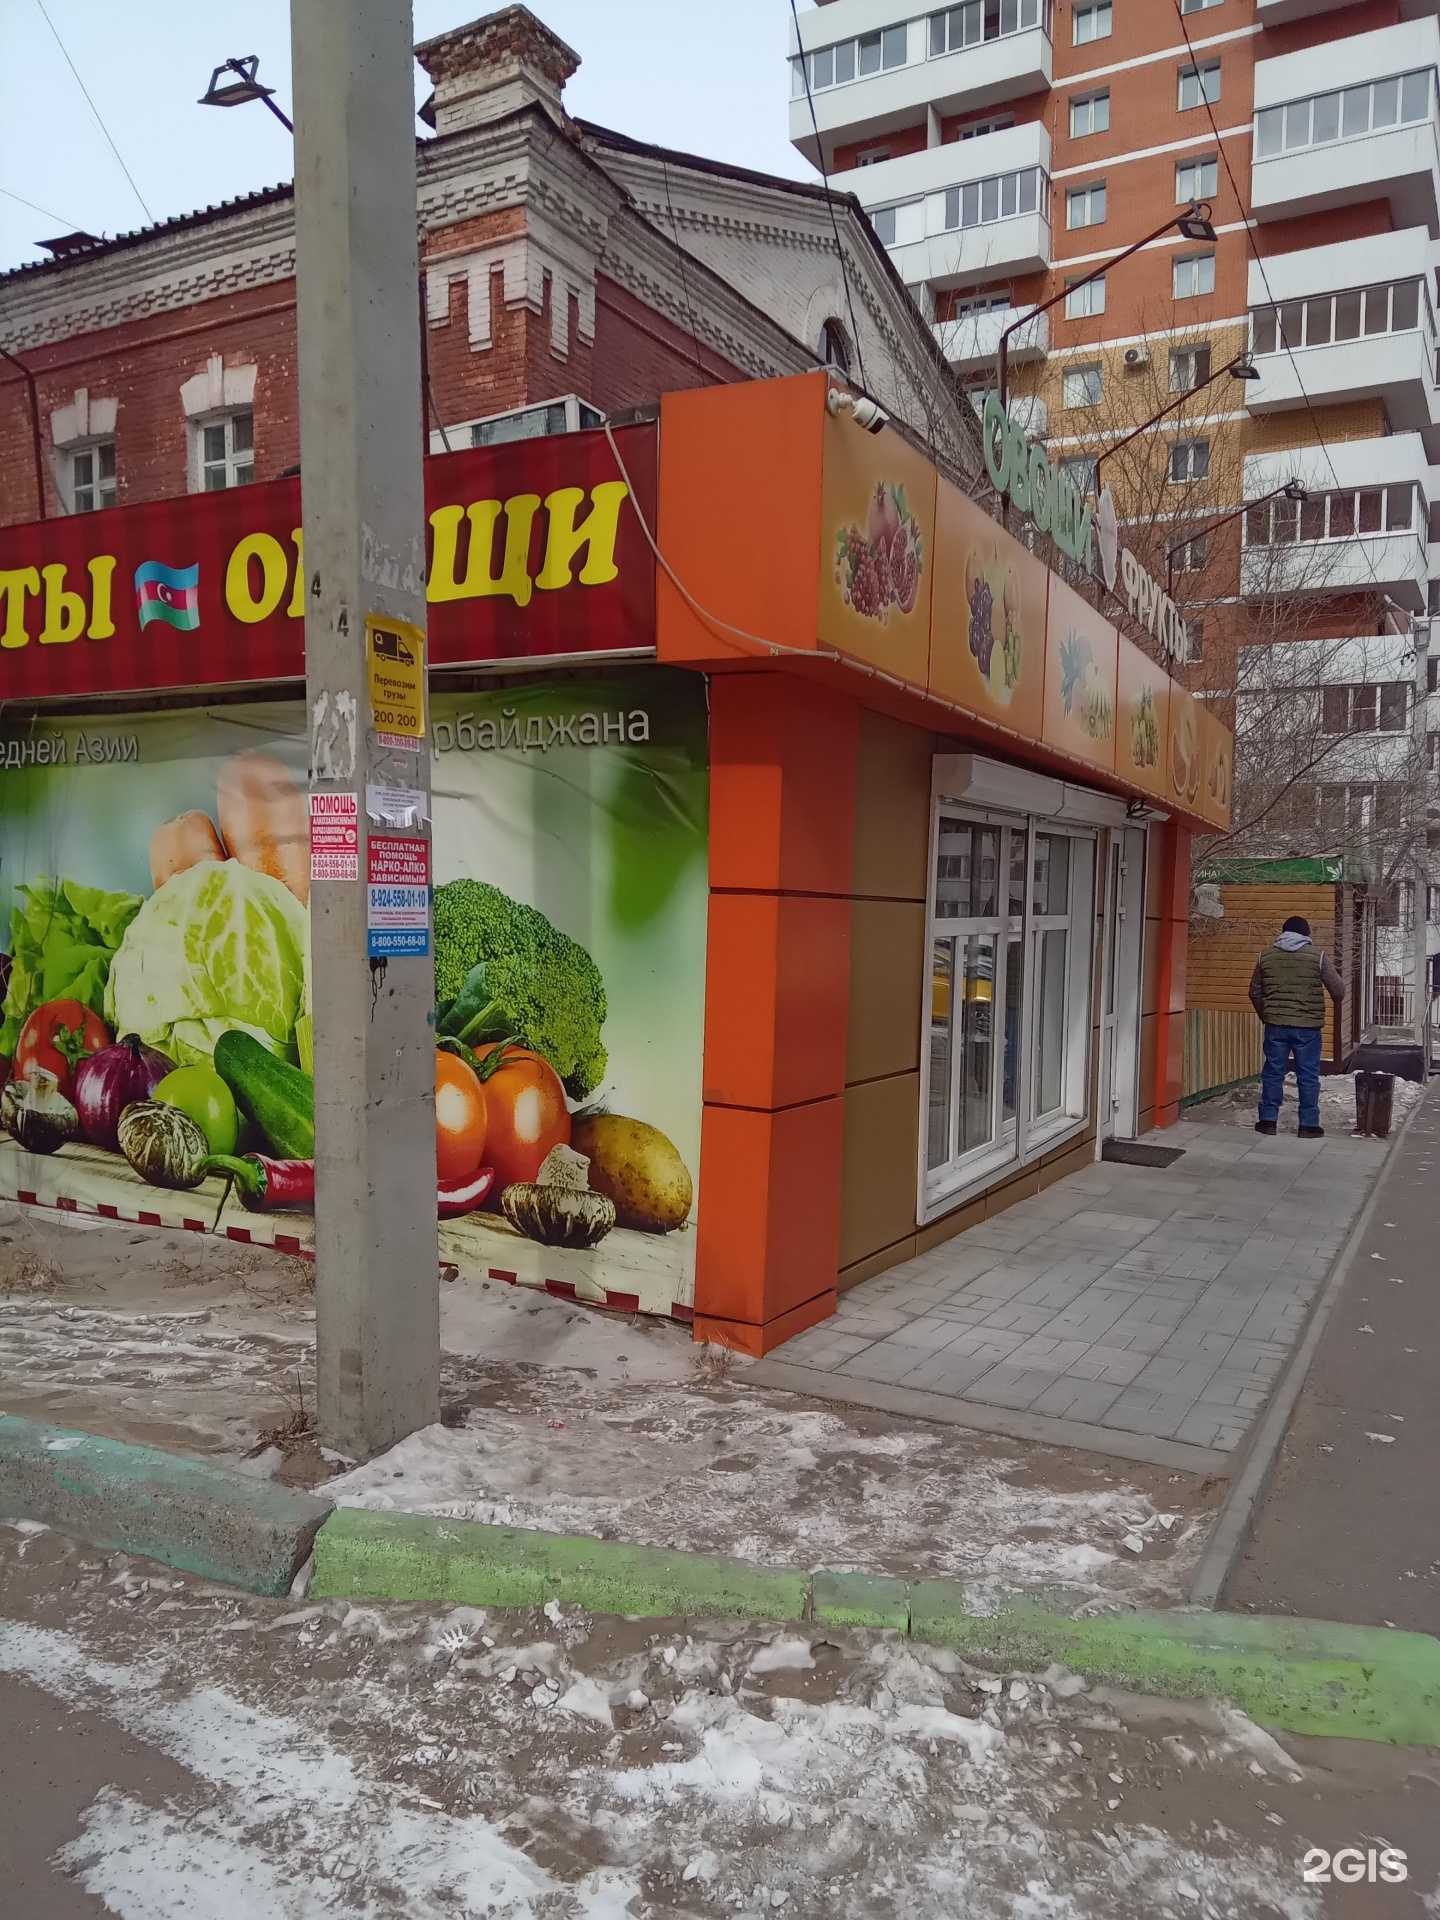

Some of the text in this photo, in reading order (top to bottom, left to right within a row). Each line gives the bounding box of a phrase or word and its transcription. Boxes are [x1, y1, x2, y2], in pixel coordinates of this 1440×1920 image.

[983, 391, 1091, 575] ОВОЩИ
[225, 481, 629, 623] ОЩИ
[1122, 547, 1187, 667] ФРУКТЫ
[374, 673, 416, 690] Перевозим
[383, 689, 406, 701] грузы
[374, 710, 417, 728] 200 200
[431, 708, 650, 760] рбайджана
[75, 730, 138, 762] Азии
[312, 795, 356, 815] ПОМОЩЬ
[371, 841, 425, 853] БЕСПЛАТНАЯ
[379, 851, 417, 861] ПОМОЩЬ
[371, 860, 425, 873] НАРКО-АЛКО
[371, 873, 426, 884] ЗАВИСИМЫМ
[371, 889, 426, 908] 8-924-558-01-10
